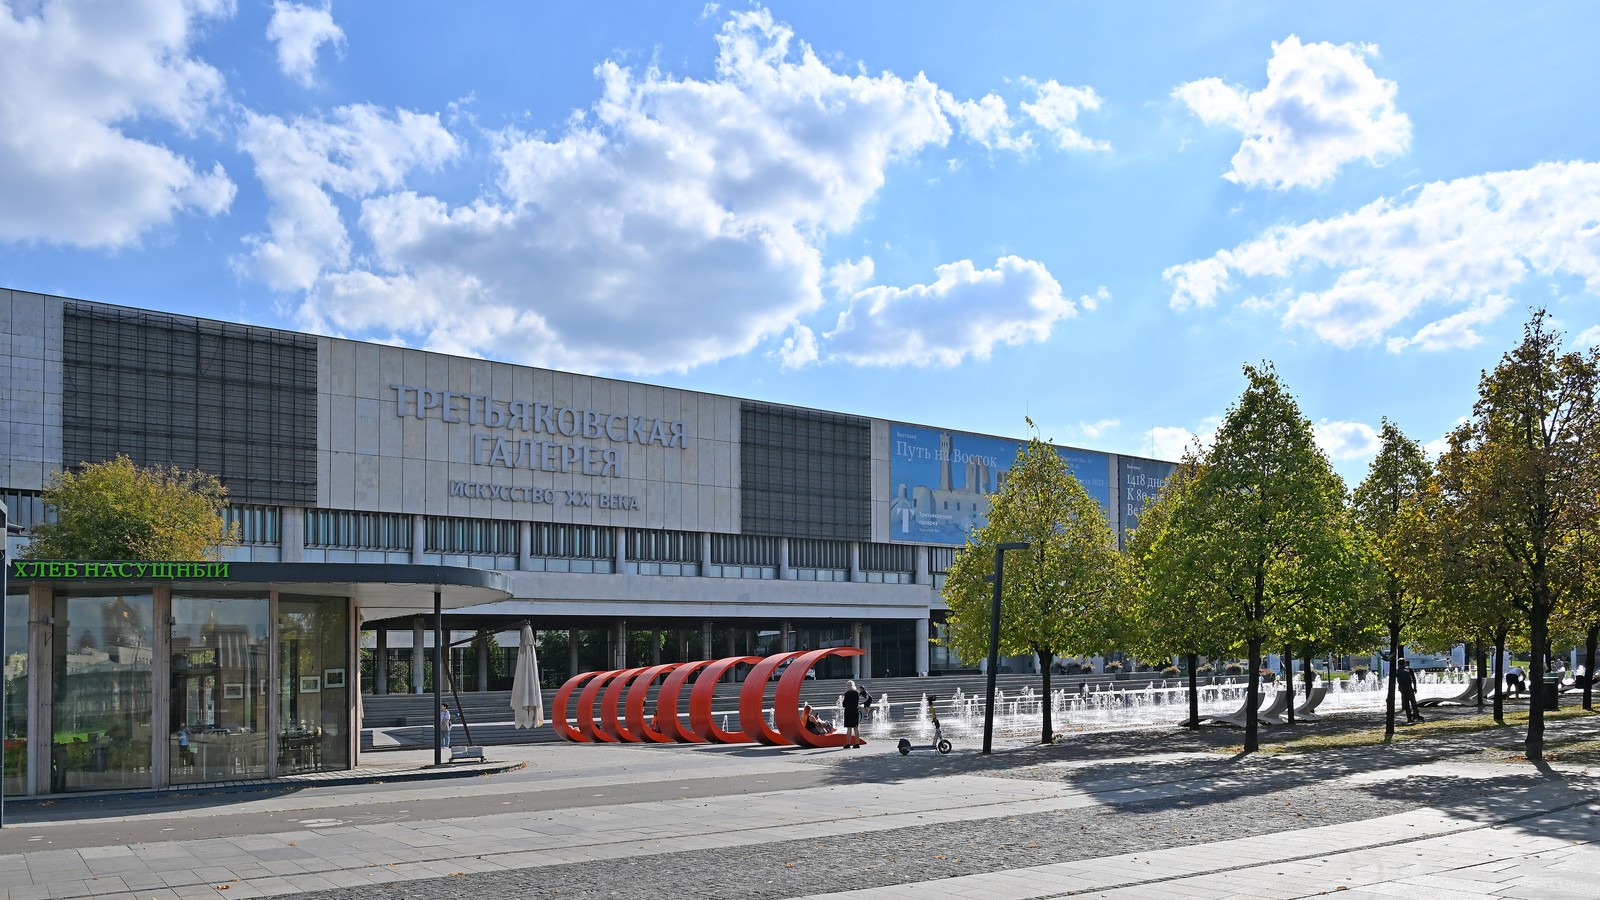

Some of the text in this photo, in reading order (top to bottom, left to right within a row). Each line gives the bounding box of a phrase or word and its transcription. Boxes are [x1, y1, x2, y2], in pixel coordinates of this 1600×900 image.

[390, 384, 689, 449] ТРЕТЬЯКОВСКАЯ
[473, 434, 622, 478] ГАЛЕРЕЯ
[896, 440, 998, 468] Путь на Восток
[1126, 473, 1146, 487] 1418
[1126, 487, 1135, 501] К
[449, 479, 555, 505] ИСКУССТВО
[599, 493, 641, 511] ВЕКА
[14, 561, 230, 580] ХЛЕБ НАСУЩНЫЙ
